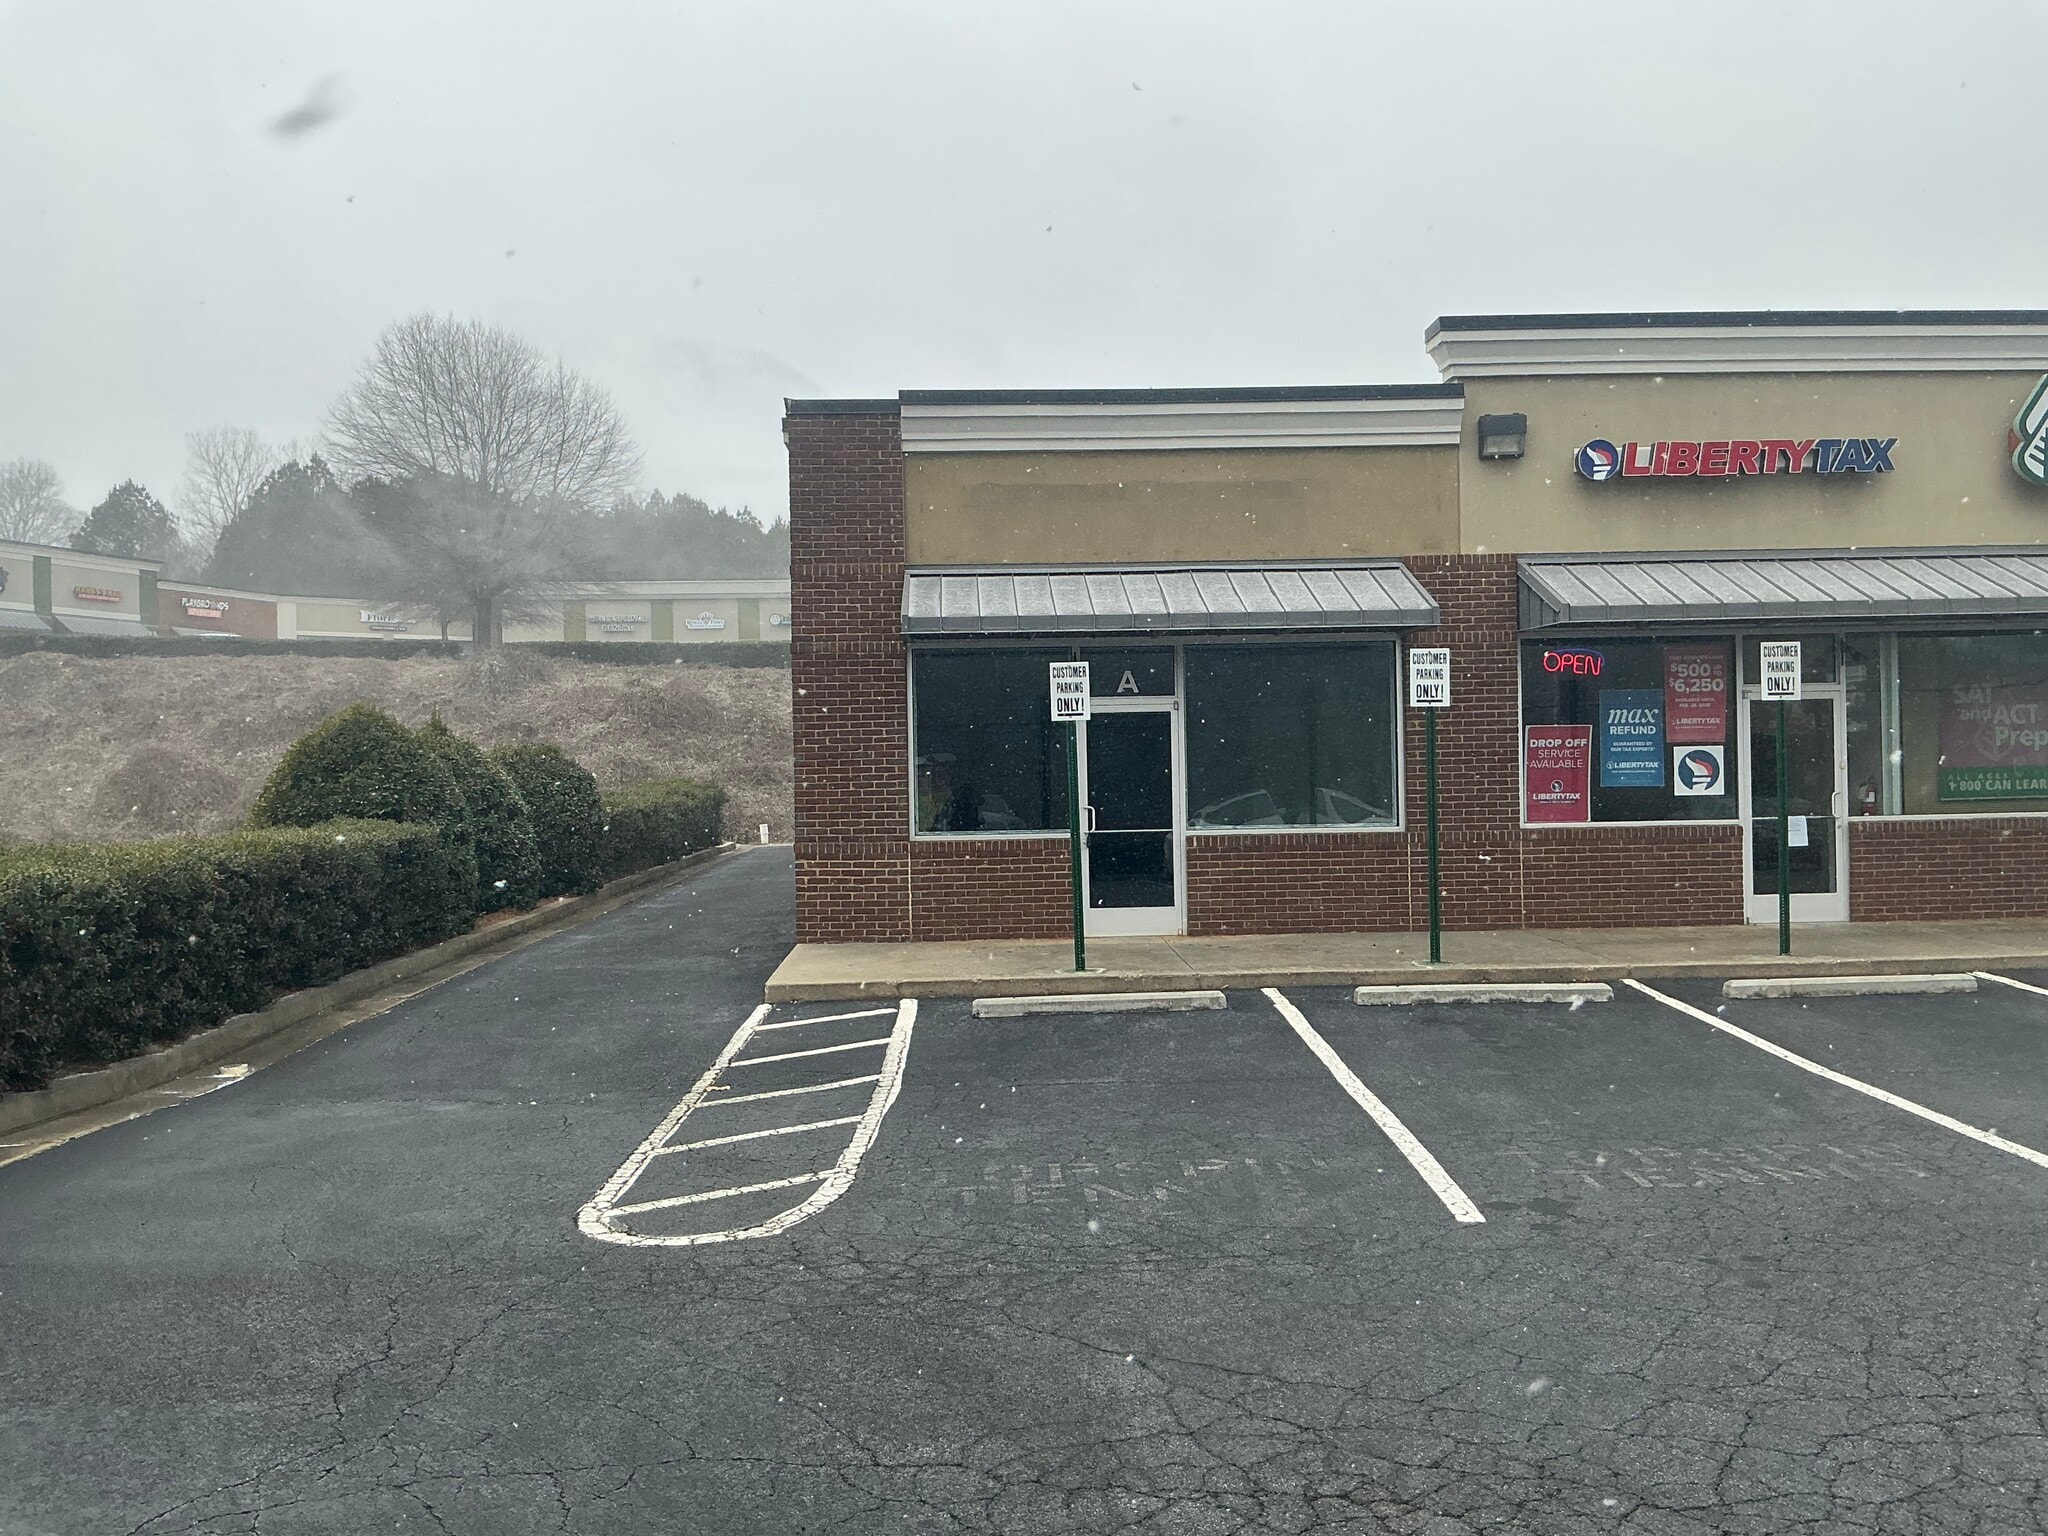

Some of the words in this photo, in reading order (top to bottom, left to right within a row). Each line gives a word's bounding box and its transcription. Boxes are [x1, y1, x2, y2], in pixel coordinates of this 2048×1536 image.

[602, 623, 634, 632] DENTAL
[1763, 645, 1798, 658] CUSTOMER
[1412, 652, 1447, 665] CUSTOMER
[1543, 652, 1601, 676] OPEN
[1052, 666, 1087, 679] CUSTOMER
[1670, 662, 1711, 677] $500
[1767, 661, 1795, 673] PARKING
[1416, 668, 1444, 680] PARKING
[1056, 681, 1084, 694] PARKING
[1117, 670, 1139, 693] A
[1669, 677, 1724, 694] $6,250
[1767, 676, 1795, 691] ONLY!
[1416, 684, 1444, 698] ONLY!
[1057, 697, 1084, 712] ONLY!
[1607, 708, 1659, 724] max
[1960, 704, 1992, 720] and
[1993, 704, 2039, 724] ACT
[1610, 725, 1656, 735] REFUND
[1529, 739, 1562, 748] DROP
[1565, 738, 1588, 747] OFF
[1995, 726, 2048, 751] Prep
[1538, 749, 1580, 758] SERVICE
[1985, 779, 2011, 790] CAN
